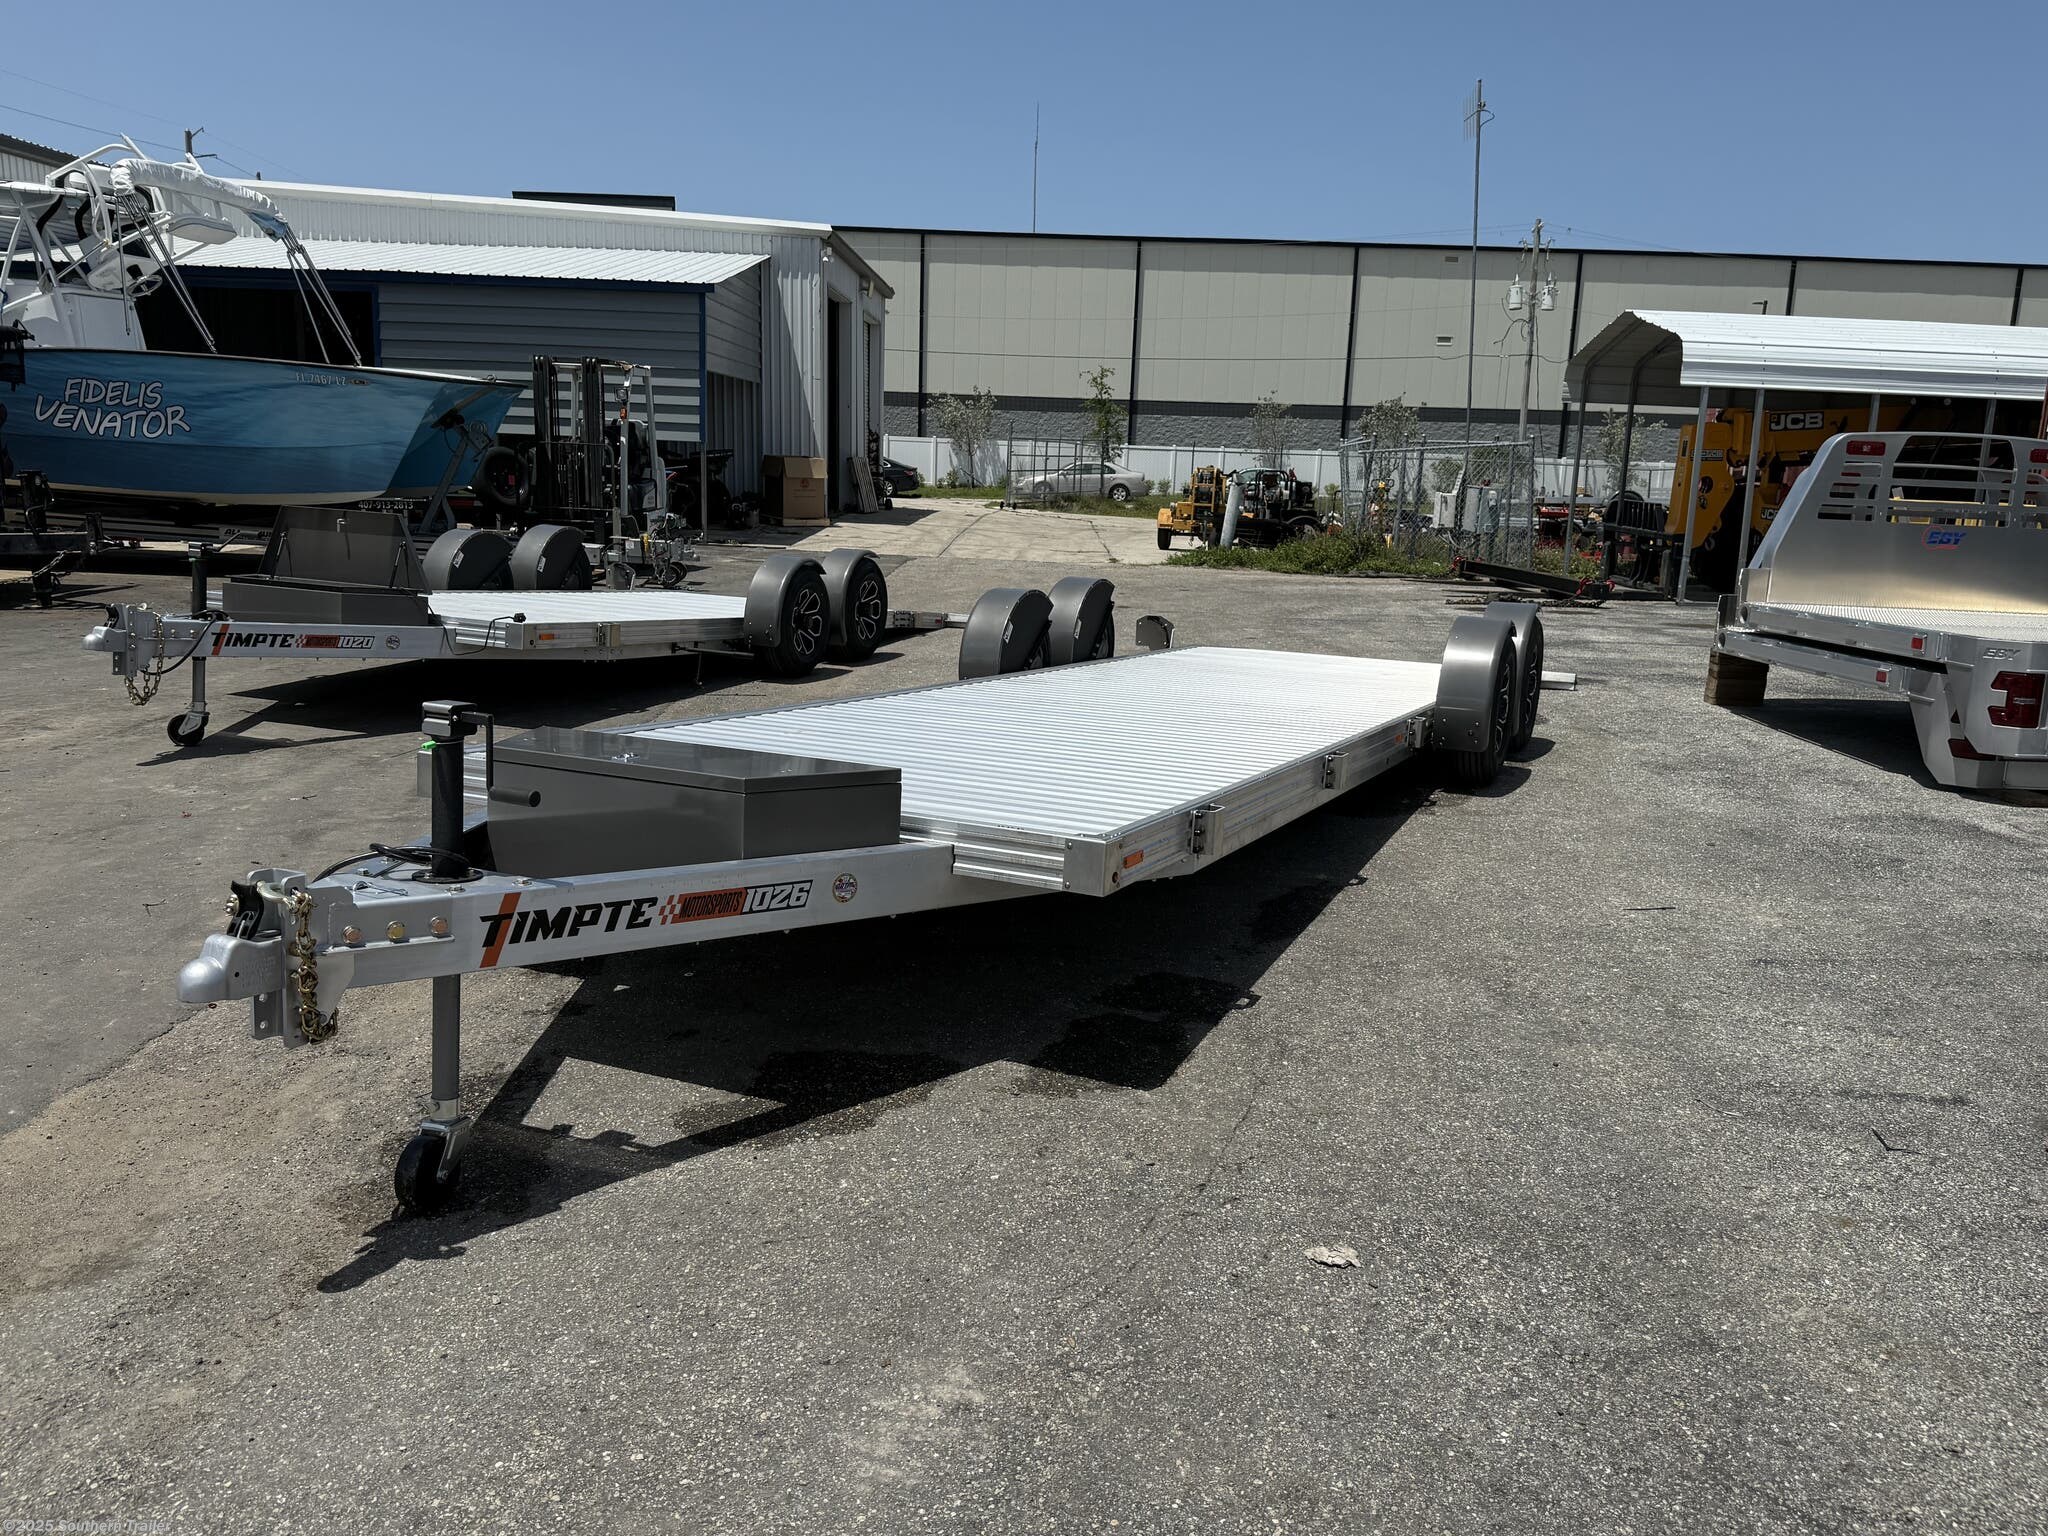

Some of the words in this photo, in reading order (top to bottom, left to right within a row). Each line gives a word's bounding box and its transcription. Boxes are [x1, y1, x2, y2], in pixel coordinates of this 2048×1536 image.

[64, 377, 163, 409] FIDELIS
[34, 394, 192, 438] VENATOR
[1770, 412, 1824, 430] JCB
[1761, 508, 1778, 520] JC
[1926, 531, 1967, 545] EBY
[210, 631, 296, 648] TIMPTE
[336, 635, 375, 649] 1020
[1982, 647, 2021, 661] EBY
[479, 896, 659, 950] TIMPTE
[678, 889, 744, 920] MOTORSPORTS
[742, 880, 813, 914] 1026
